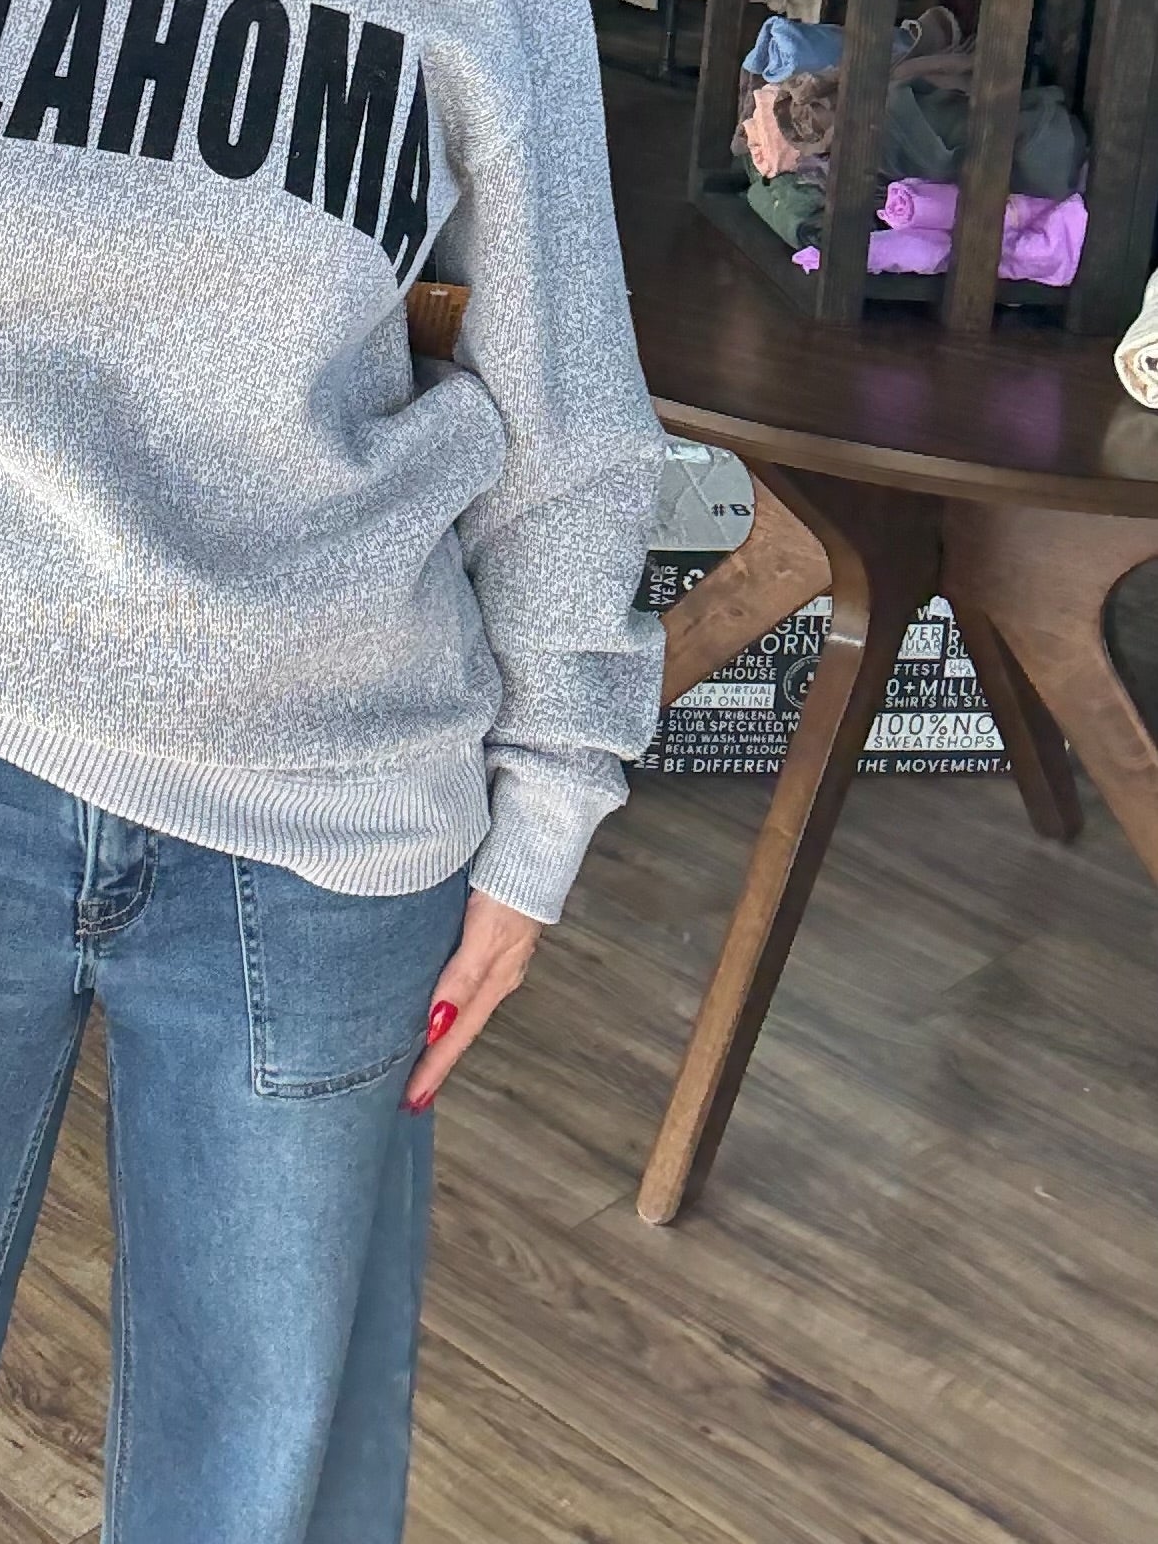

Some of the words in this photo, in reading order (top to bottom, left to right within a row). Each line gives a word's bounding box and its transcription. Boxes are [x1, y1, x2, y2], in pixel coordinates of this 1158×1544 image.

[662, 565, 678, 605] YEAR
[744, 634, 819, 656] ORN
[722, 685, 772, 696] VIRTUAL
[718, 695, 772, 708] ONLINE
[884, 695, 938, 709] SHIRTS
[942, 695, 960, 708] IN
[667, 733, 697, 744] ACID
[873, 735, 995, 749] SWEATSHOPS
[665, 743, 719, 755] RELAXED
[663, 757, 686, 773] BE
[692, 758, 787, 774] DIFFEREN
